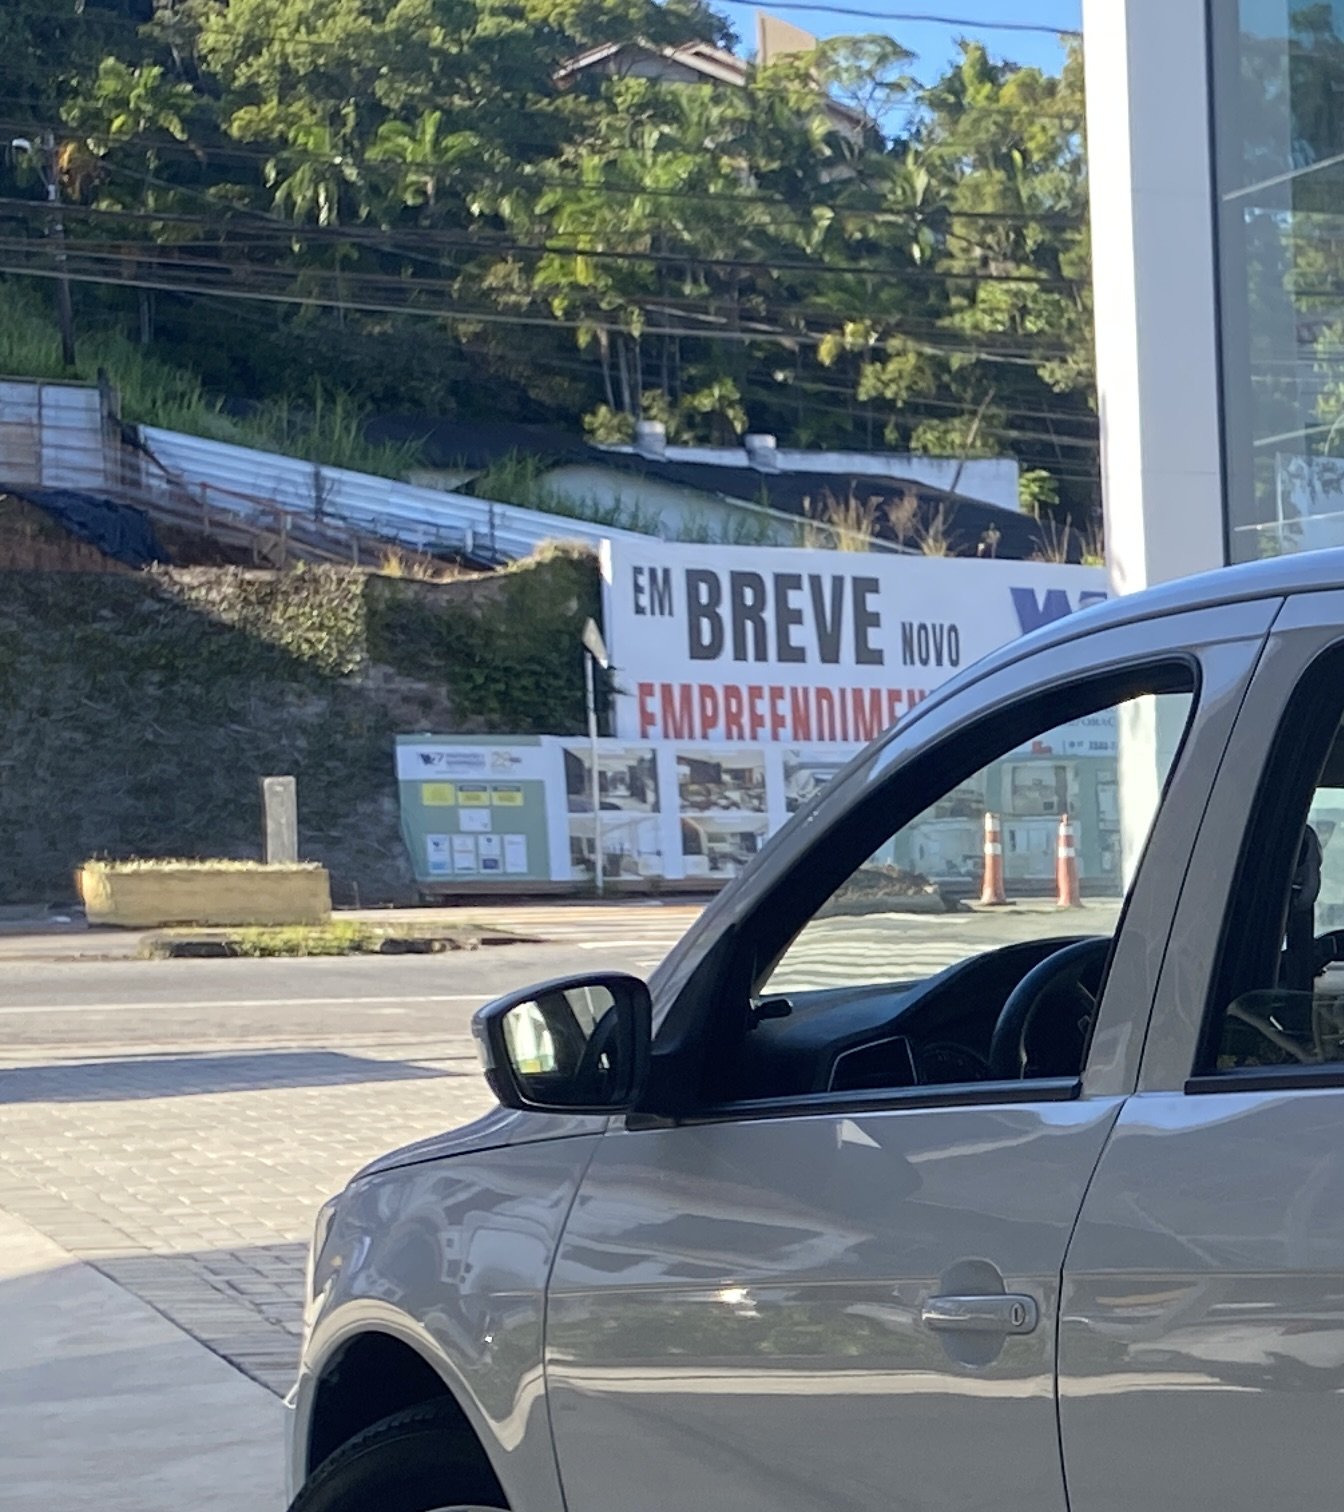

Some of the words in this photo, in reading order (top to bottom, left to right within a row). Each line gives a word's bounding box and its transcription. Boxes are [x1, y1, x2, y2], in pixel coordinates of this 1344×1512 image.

[633, 566, 674, 616] EM
[685, 568, 885, 667] BREVE
[900, 621, 961, 667] NOVO
